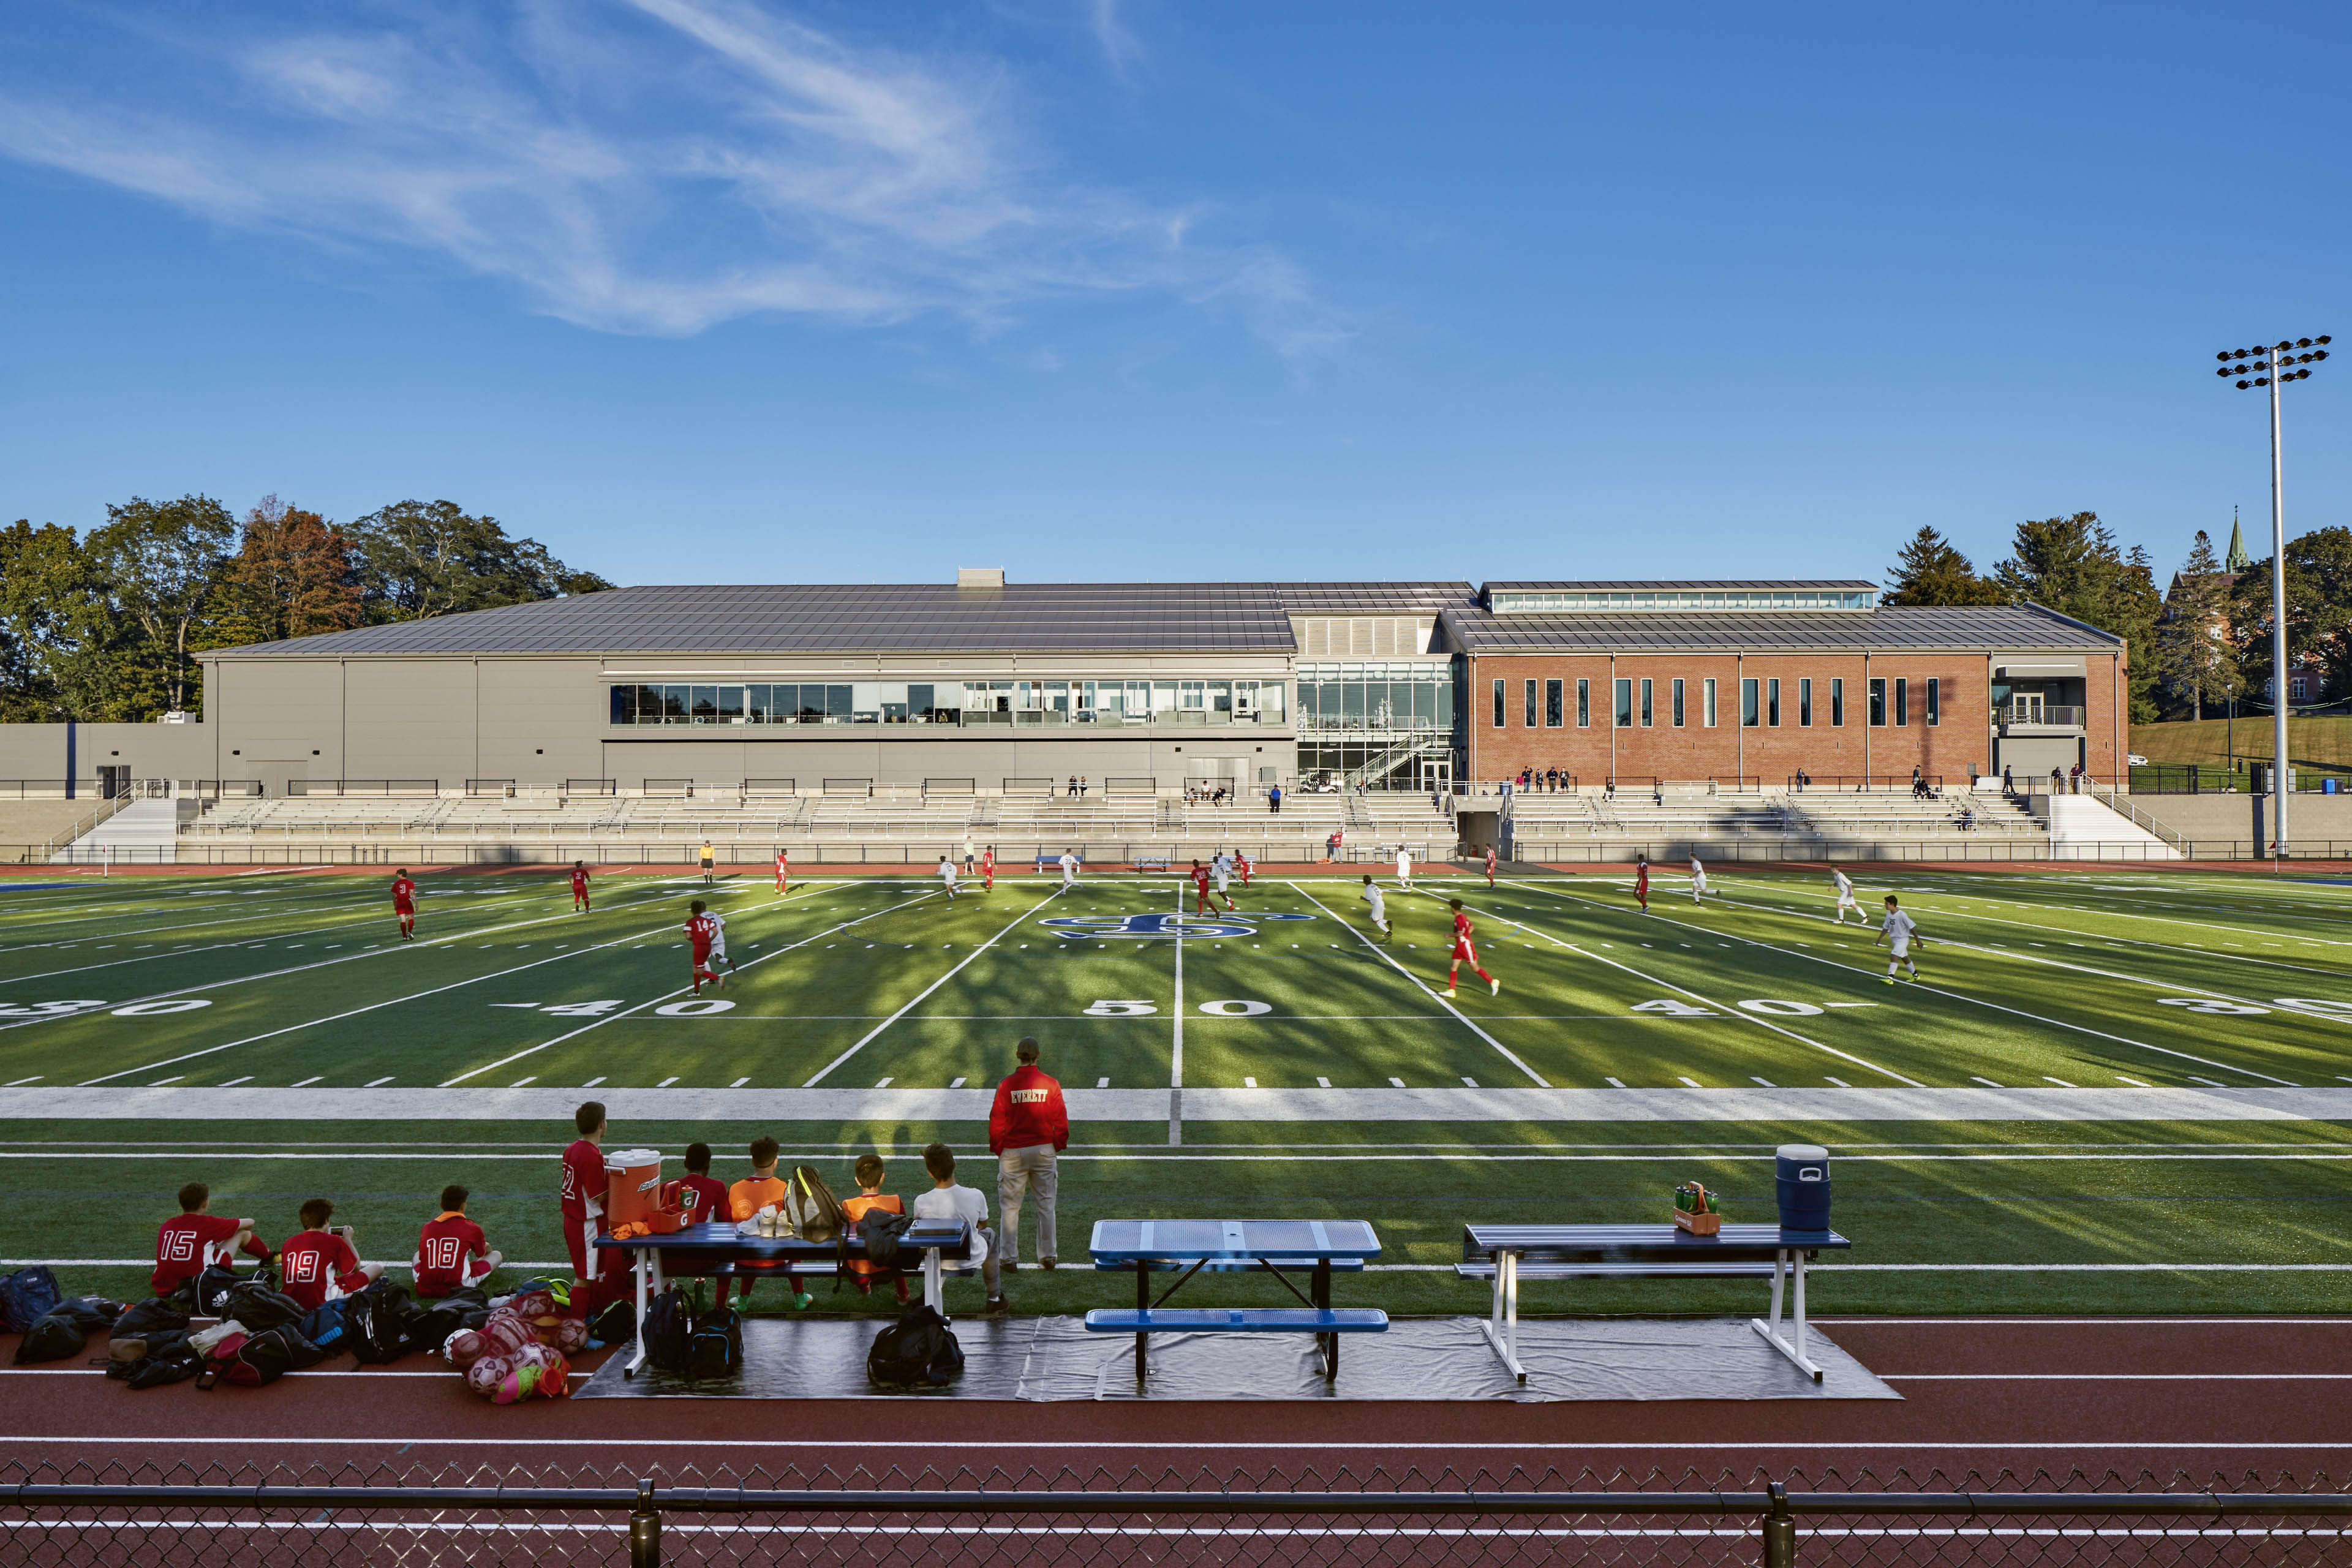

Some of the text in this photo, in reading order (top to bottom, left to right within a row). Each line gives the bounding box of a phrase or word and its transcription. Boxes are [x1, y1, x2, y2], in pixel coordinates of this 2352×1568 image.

[399, 884, 406, 894] 3
[696, 919, 709, 932] 14
[1010, 1088, 1048, 1104] EVERETT
[684, 1197, 692, 1206] G
[680, 1212, 688, 1226] G
[160, 1230, 197, 1261] 15
[426, 1237, 459, 1269] 18
[285, 1250, 320, 1284] 19
